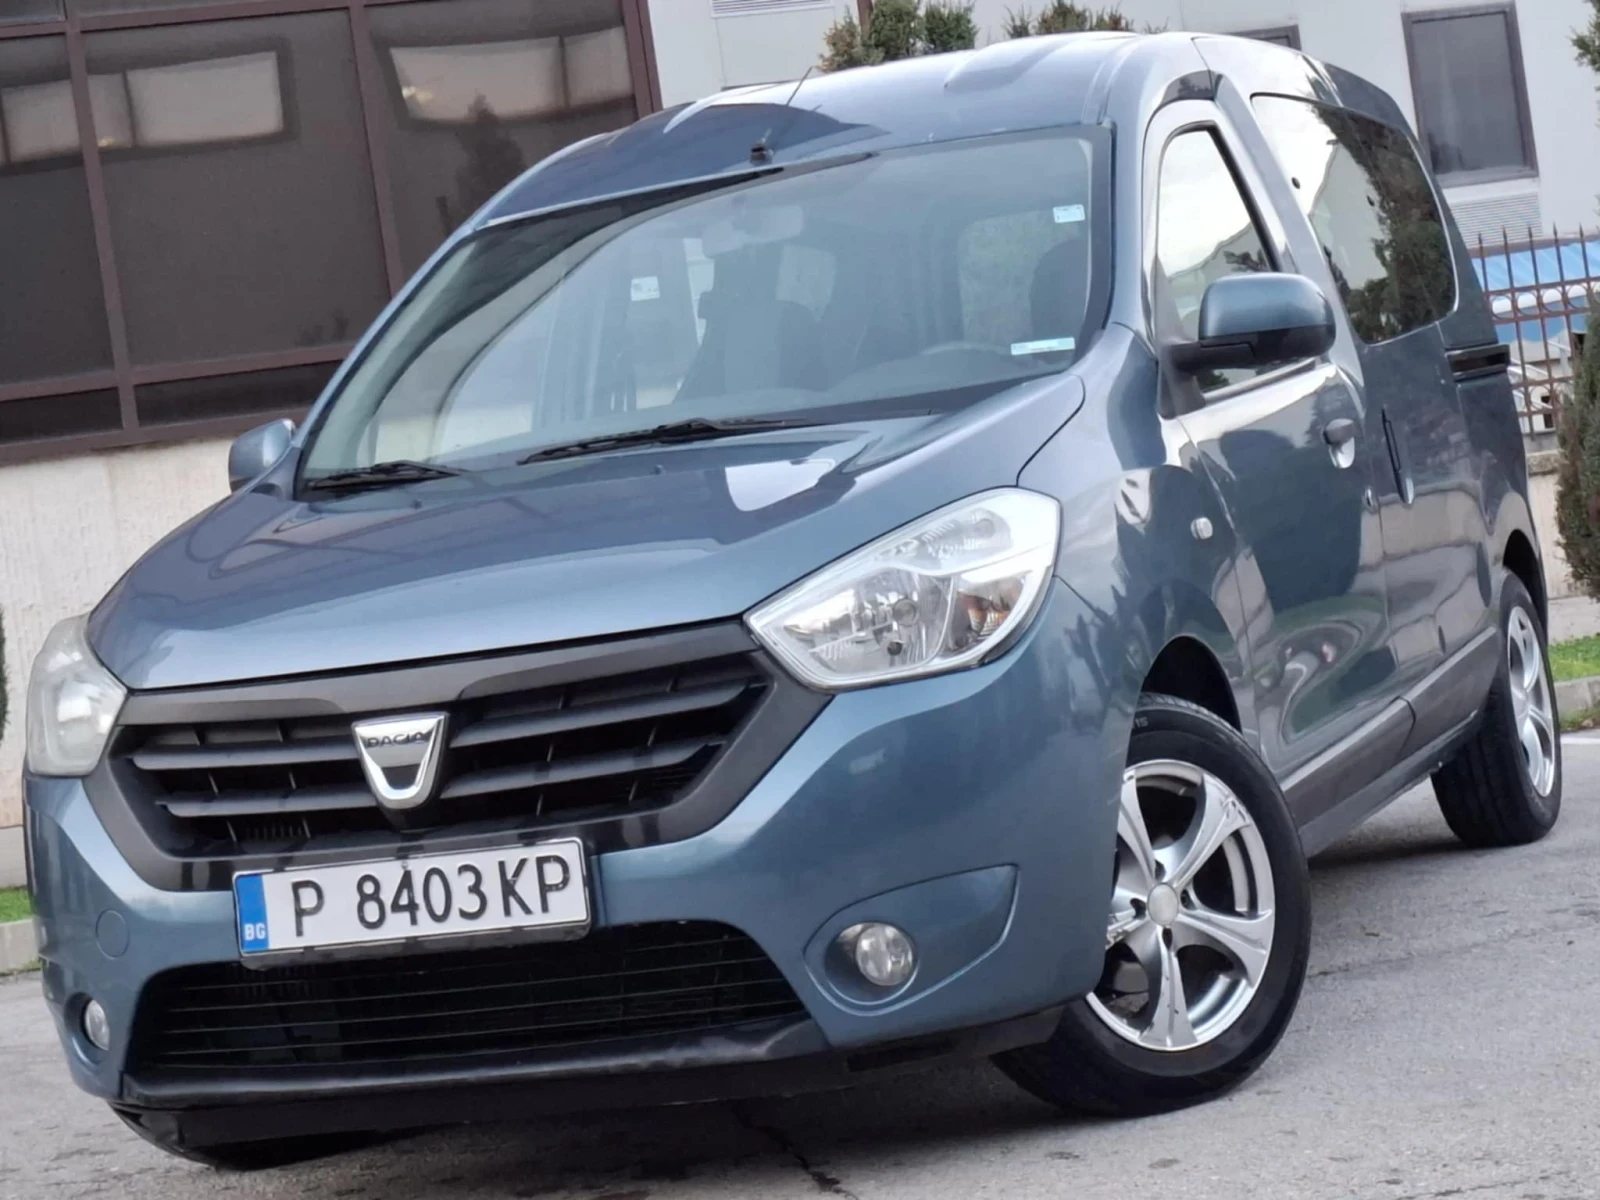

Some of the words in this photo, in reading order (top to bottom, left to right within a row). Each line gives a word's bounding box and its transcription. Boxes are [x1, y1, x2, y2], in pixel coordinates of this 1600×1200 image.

[366, 731, 425, 747] DACIA
[291, 880, 324, 937] P
[356, 864, 488, 929] 8403
[498, 854, 570, 917] KP
[245, 923, 265, 940] BG
